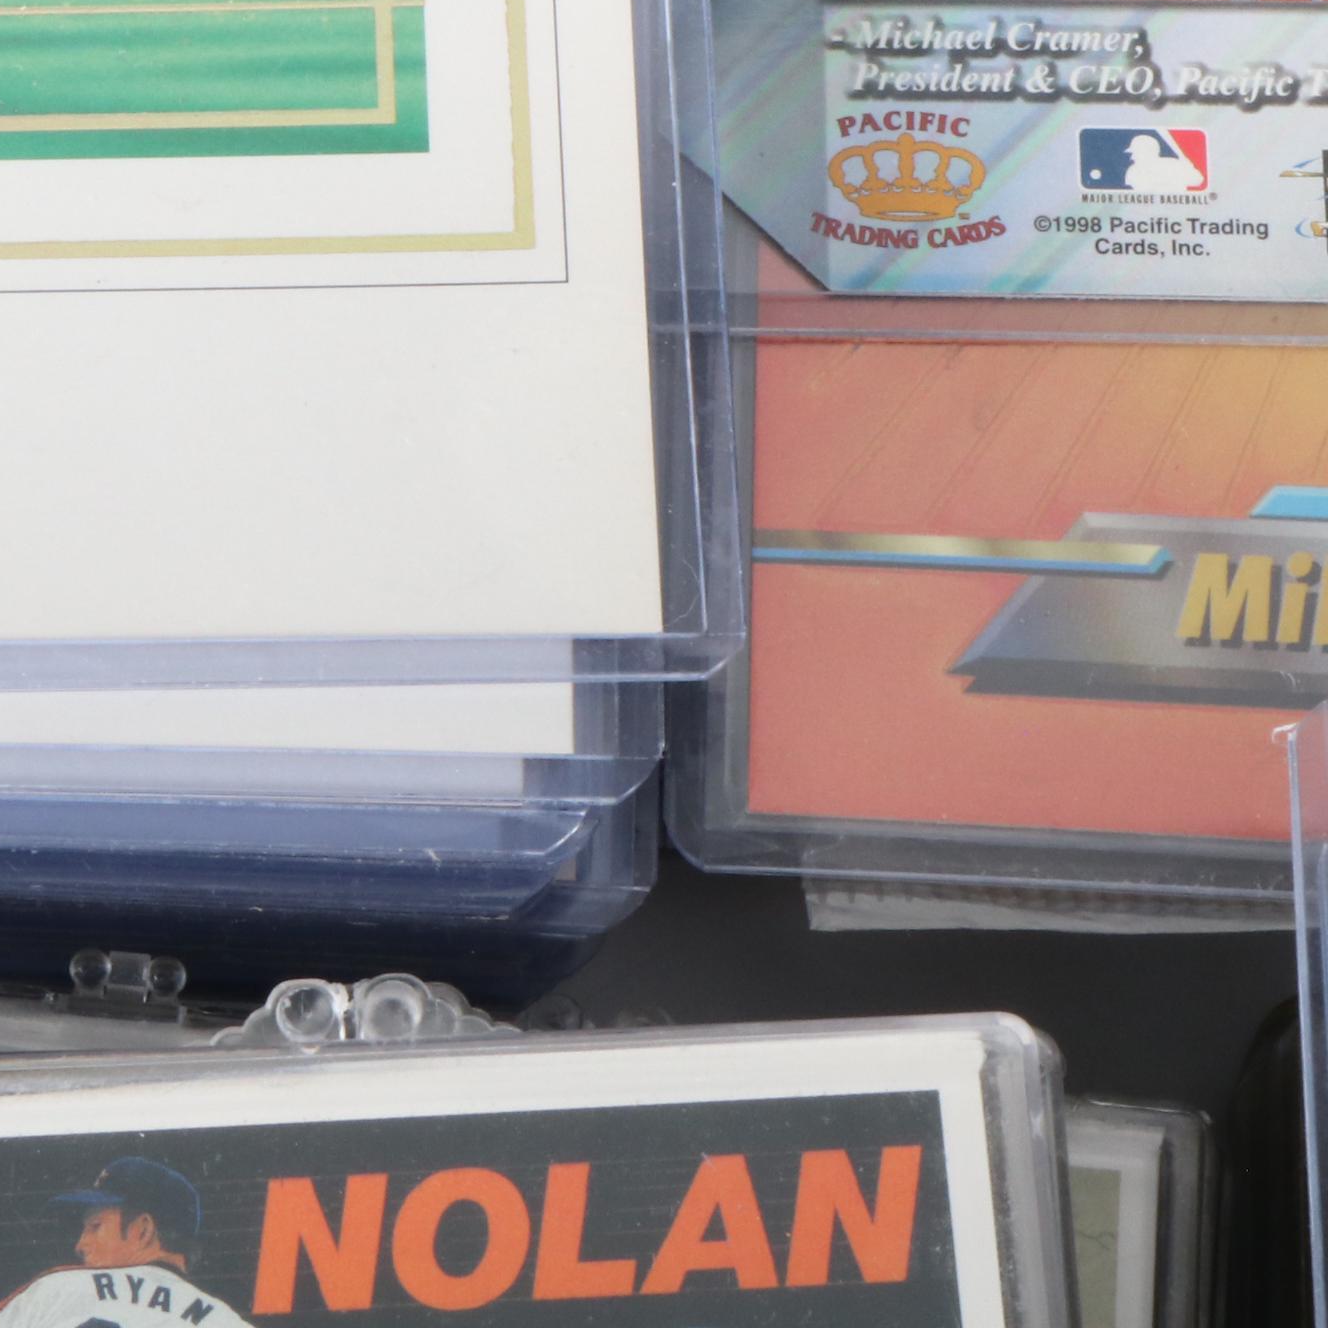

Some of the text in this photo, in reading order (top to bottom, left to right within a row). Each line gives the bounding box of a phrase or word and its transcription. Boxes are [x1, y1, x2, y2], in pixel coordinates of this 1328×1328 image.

[854, 19, 995, 50] Michael
[1007, 22, 1145, 59] Cramer,
[852, 62, 1014, 94] President
[1025, 63, 1056, 94] &
[1069, 65, 1161, 99] CEO,
[1175, 68, 1295, 103] Pacific
[836, 110, 971, 139] PACIFIC
[1081, 193, 1114, 204] MAJOR
[1118, 193, 1155, 205] LEAGUE
[810, 212, 1008, 250] TRADING CARDS
[1095, 238, 1212, 259] Cards, Inc.
[1110, 217, 1182, 236] Pacific
[1186, 218, 1270, 241] Trading
[1175, 550, 1328, 646] Mi
[251, 1144, 923, 1312] NOLAN
[93, 1272, 214, 1327] RYAN
